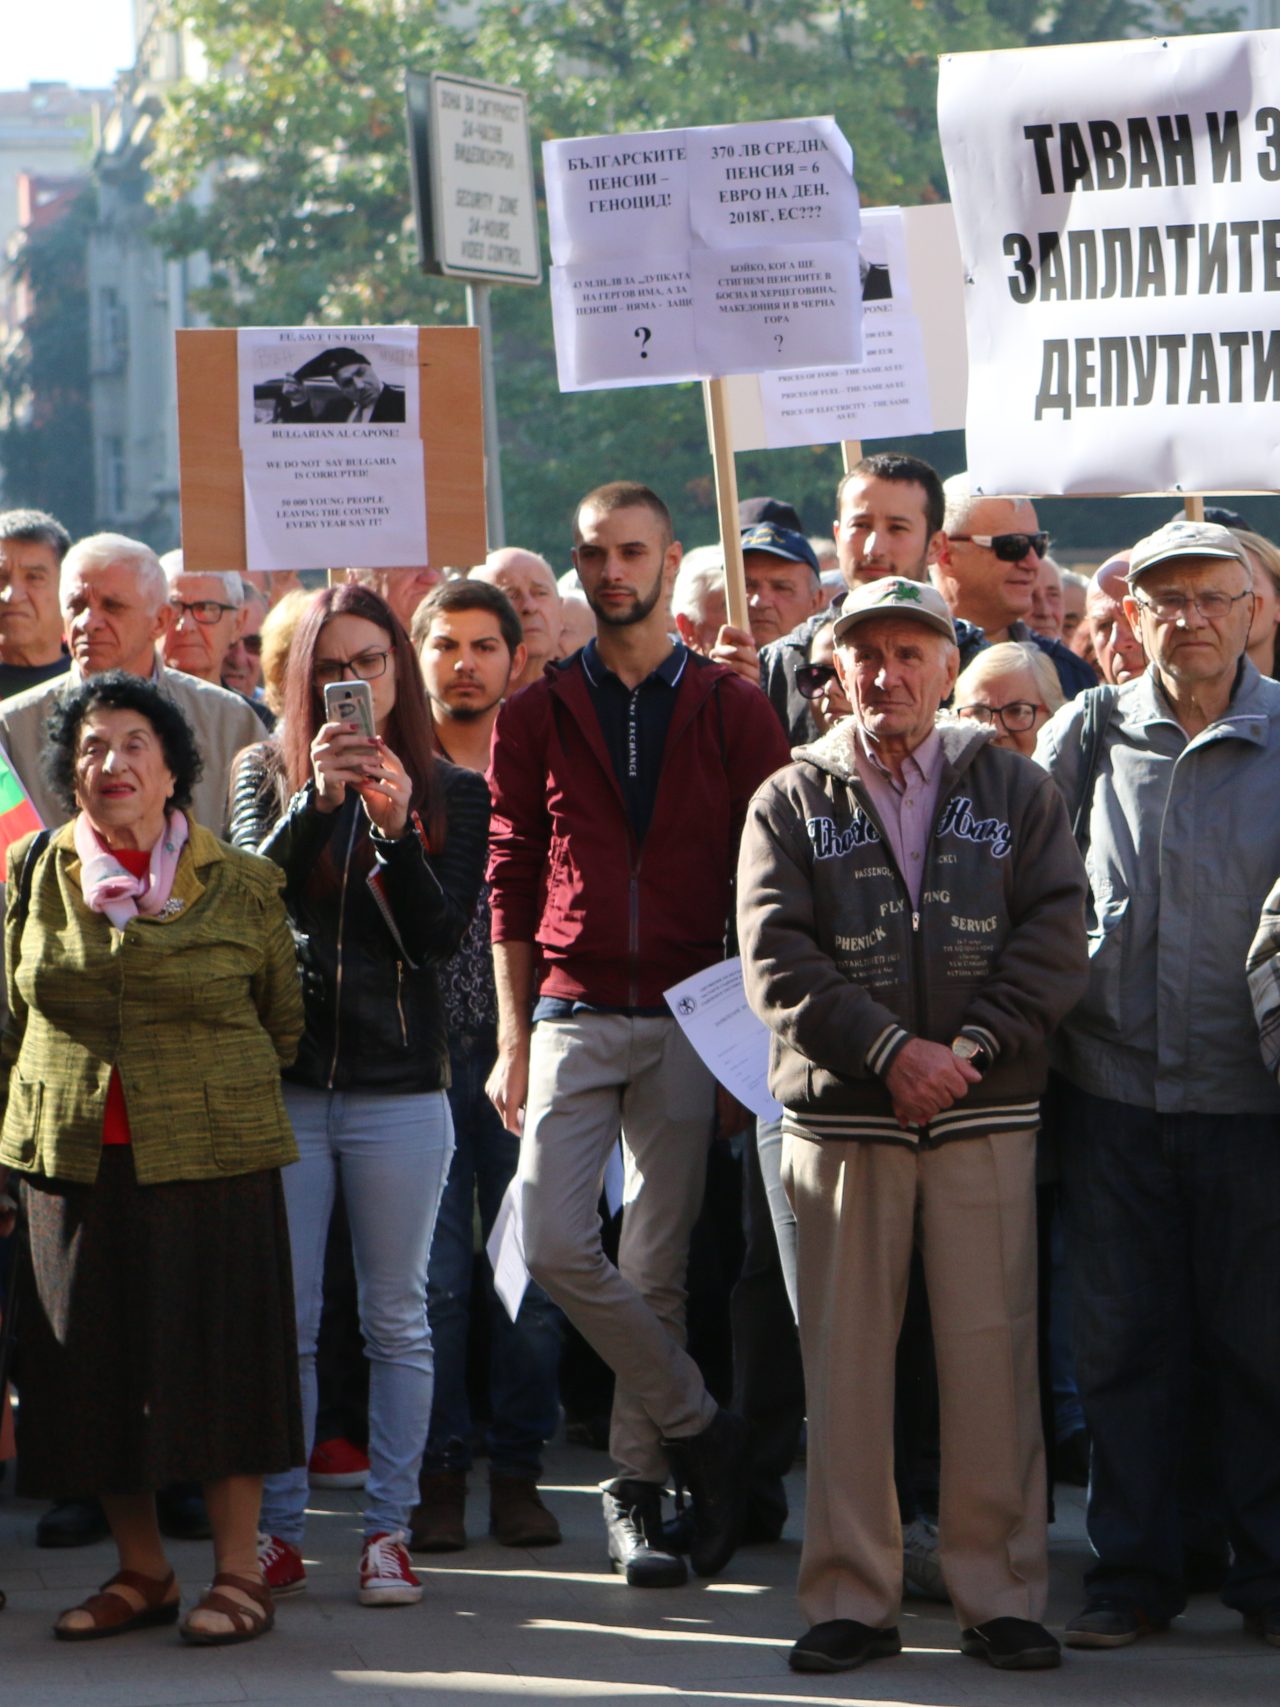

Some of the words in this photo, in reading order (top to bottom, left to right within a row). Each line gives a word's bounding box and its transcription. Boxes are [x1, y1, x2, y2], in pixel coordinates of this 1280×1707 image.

[712, 146, 734, 160] 370
[738, 144, 760, 157] ЛВ
[1023, 114, 1196, 195] ТАВАН
[1206, 110, 1242, 184] И
[568, 148, 686, 171] БЪЛГАРСКИТЕ
[726, 164, 794, 180] ПЕНСИЯ
[812, 162, 820, 174] 6
[588, 173, 656, 191] ПЕНСИИ
[456, 188, 493, 210] SECURITY
[498, 195, 519, 216] ZONE
[719, 188, 760, 203] ЕВРО
[766, 187, 788, 200] НА
[589, 194, 672, 213] ГЕНОЦИД!
[778, 206, 822, 220] ЕС???
[468, 217, 510, 240] 24-HOURS
[461, 241, 484, 261] VIDEO
[488, 246, 522, 267] CONTROL
[730, 263, 766, 273] БОЙКО,
[768, 261, 796, 271] КОГА
[798, 260, 815, 269] ЩЕ
[718, 276, 764, 287] СТИГНЕМ
[767, 273, 822, 284] ПЕНСИИТЕ
[825, 272, 832, 280] В
[583, 294, 596, 302] НА
[716, 290, 748, 300] БОСНА
[751, 289, 758, 298] И
[576, 305, 617, 316] ПЕНСИИ
[627, 302, 656, 312] НЯМА
[720, 301, 780, 312] МАКЕДОНИЯ
[783, 301, 790, 310] И
[793, 300, 799, 310] В
[801, 298, 835, 308] ЧЕРНА
[864, 304, 894, 315] PONE!
[764, 315, 790, 324] ГОРА
[343, 332, 376, 342] FROM
[634, 327, 652, 358] ?
[774, 334, 784, 352] ?
[272, 429, 334, 439] BULGARIAN
[337, 429, 350, 438] AL
[353, 428, 400, 438] CAPONE!
[267, 460, 281, 469] WE
[284, 460, 298, 468] DO
[301, 460, 320, 468] NOT
[326, 458, 344, 468] SAY
[346, 457, 396, 468] BULGARIA
[295, 472, 304, 480] IS
[306, 470, 368, 480] CORRUPTED!
[309, 496, 344, 506] YOUNG
[346, 496, 384, 505] PEOPLE
[276, 510, 320, 518] LEAVING
[321, 508, 339, 516] THE
[343, 506, 390, 516] COUNTRY
[286, 520, 318, 529] EVERY
[320, 520, 346, 528] YEAR
[349, 519, 366, 528] SAY
[629, 721, 637, 777] EXCHANGE
[951, 915, 997, 933] SERVICE
